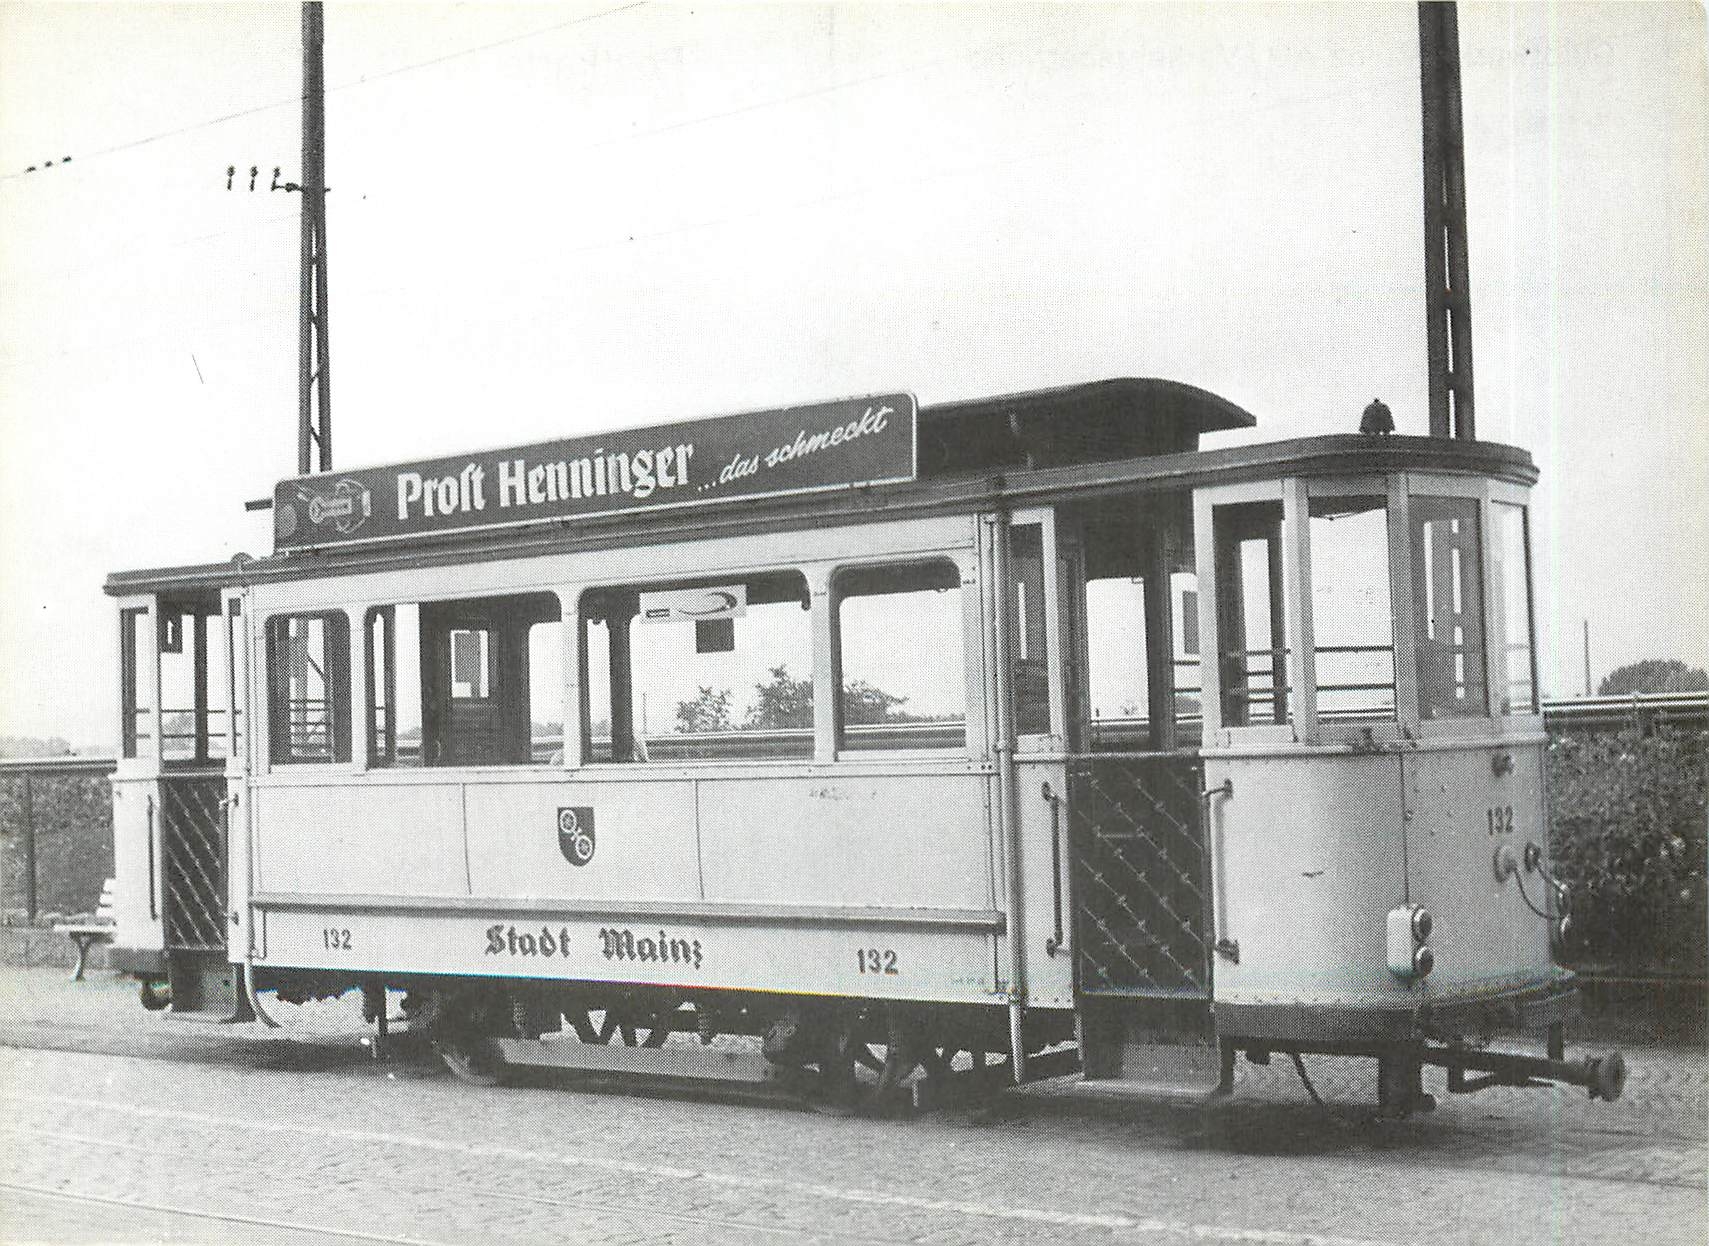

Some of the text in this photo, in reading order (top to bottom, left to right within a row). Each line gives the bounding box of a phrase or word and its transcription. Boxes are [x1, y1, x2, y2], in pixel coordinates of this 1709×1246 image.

[498, 443, 695, 508] Henninger
[763, 405, 895, 468] schmeckt
[1487, 805, 1514, 836] 132
[322, 927, 353, 951] 132
[484, 923, 704, 971] Stadt Mainz
[857, 948, 899, 976] 132
